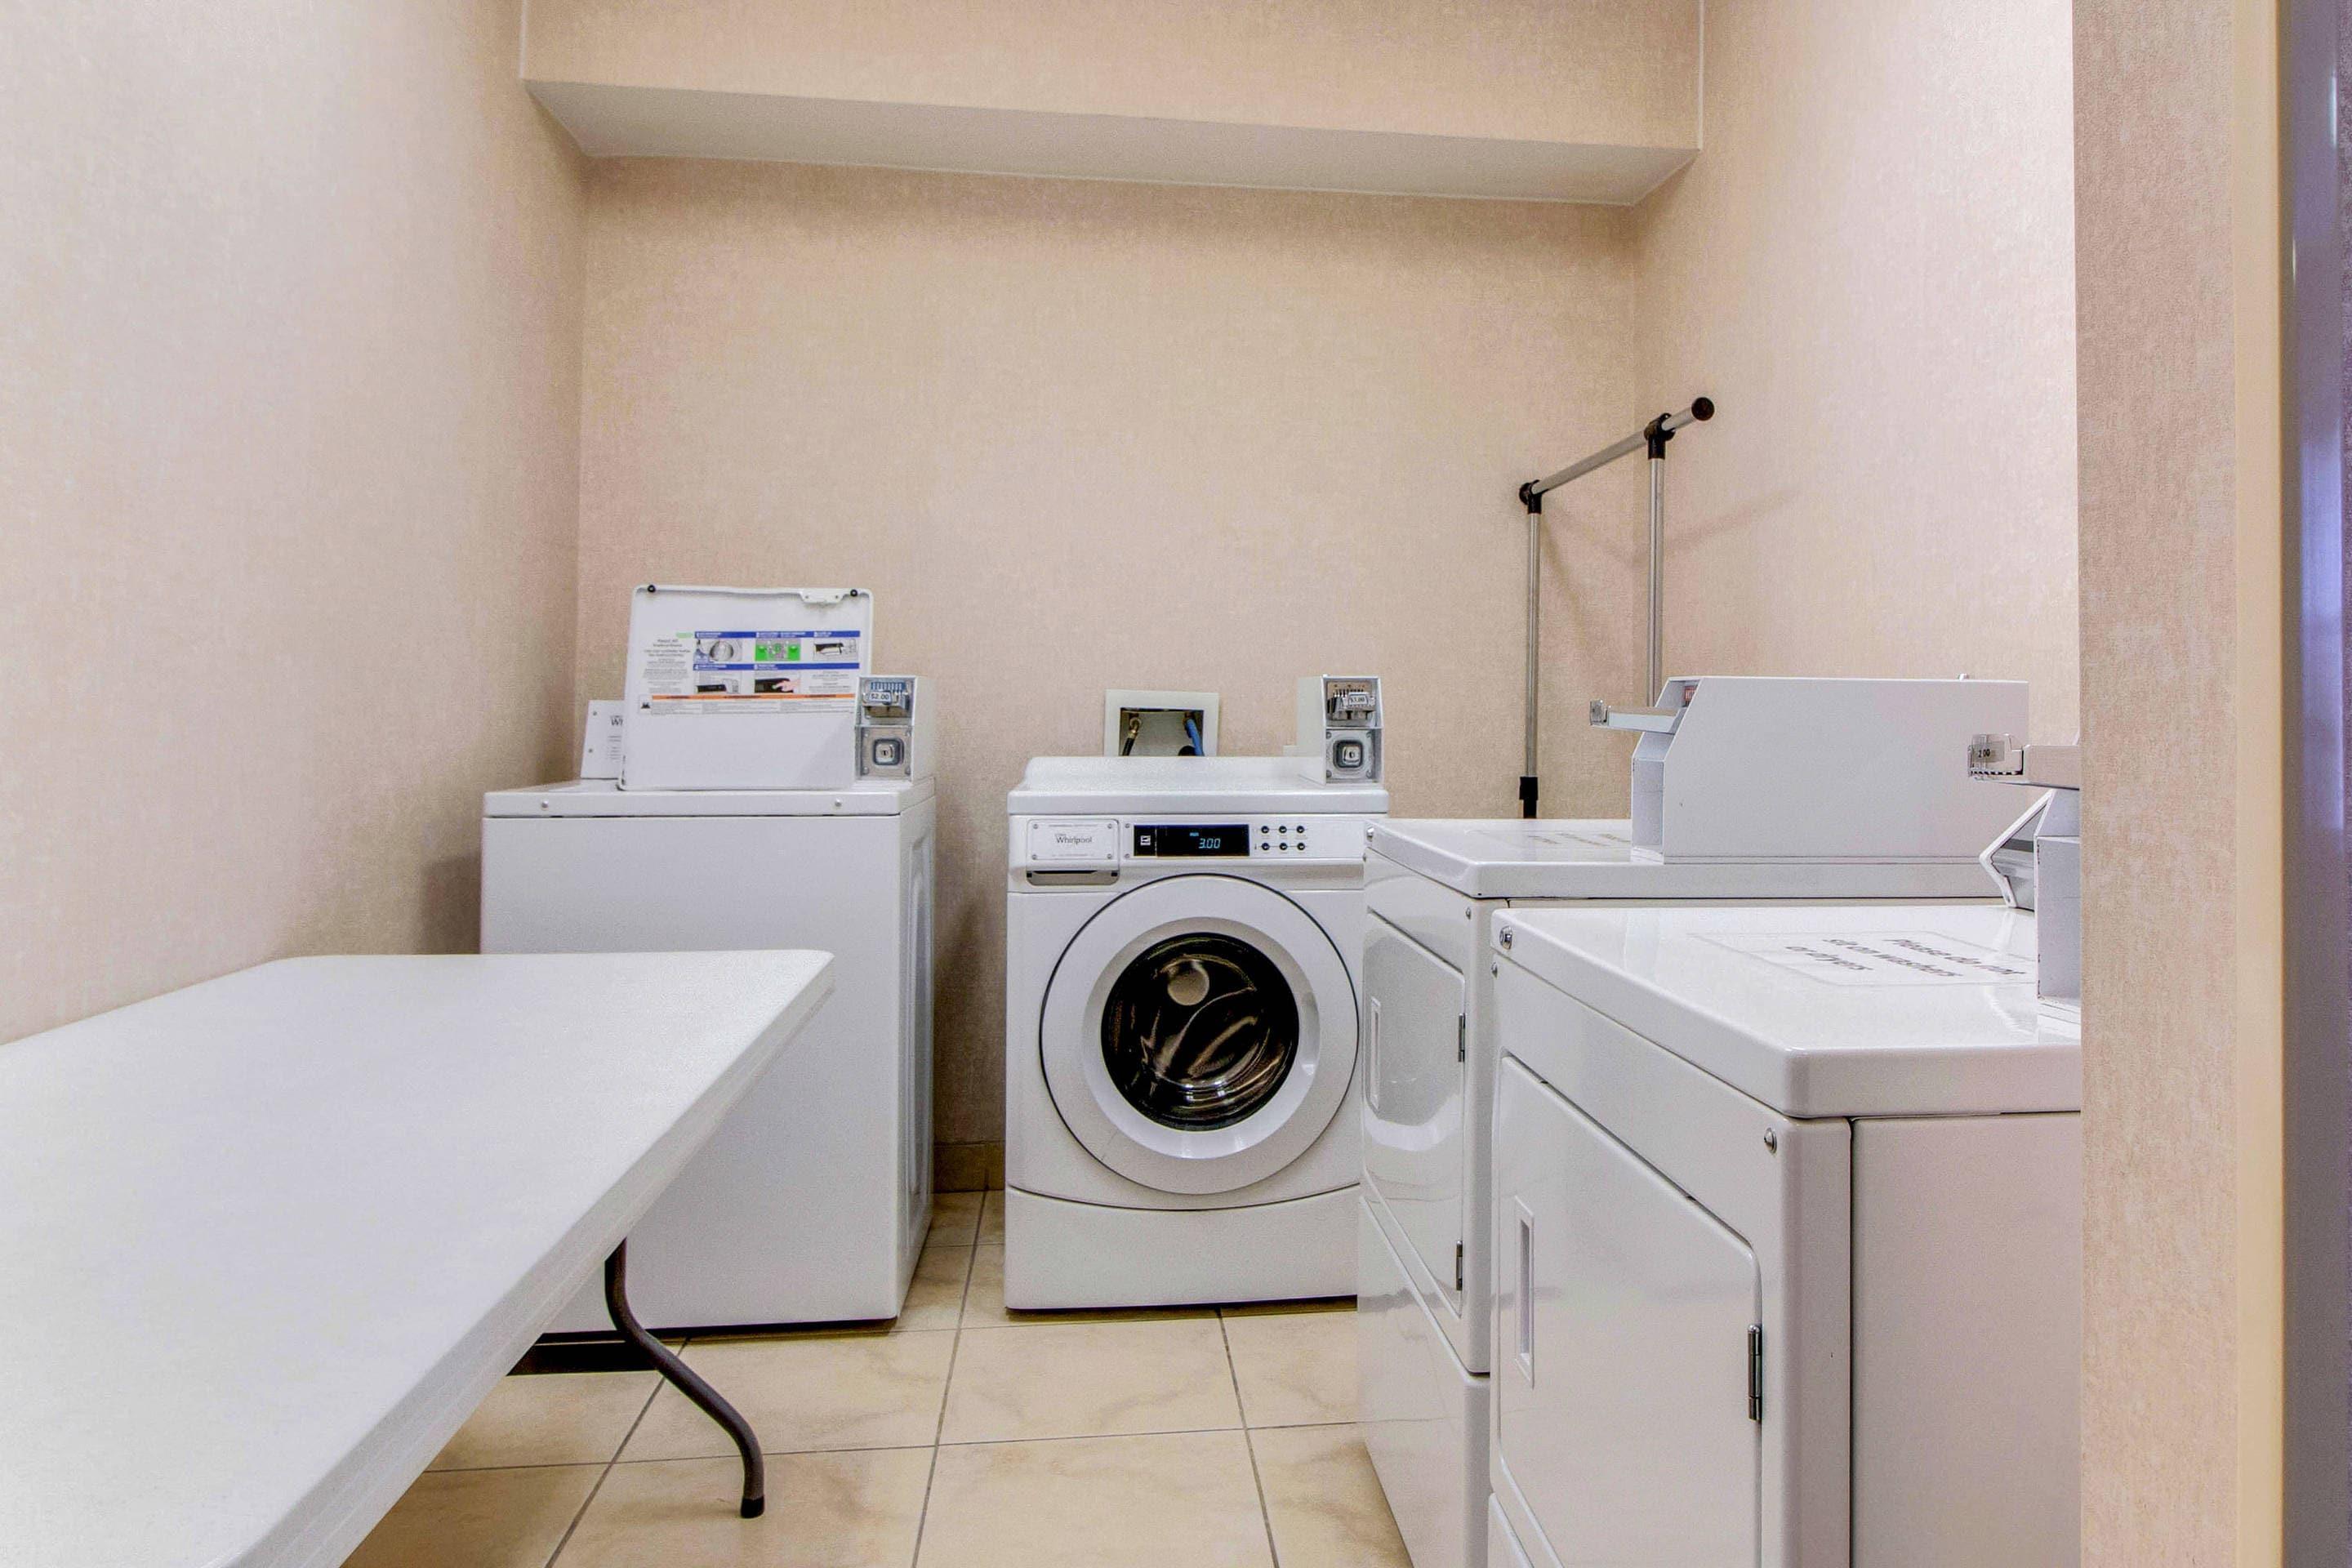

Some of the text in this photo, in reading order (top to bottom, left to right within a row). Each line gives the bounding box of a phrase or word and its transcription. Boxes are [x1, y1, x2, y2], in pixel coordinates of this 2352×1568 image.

[1055, 835, 1093, 845] Whirlpool
[1198, 838, 1221, 849] 3.00
[1806, 952, 1874, 970] dryers
[1873, 954, 1963, 976] washers
[1882, 939, 2027, 974] Please do not
